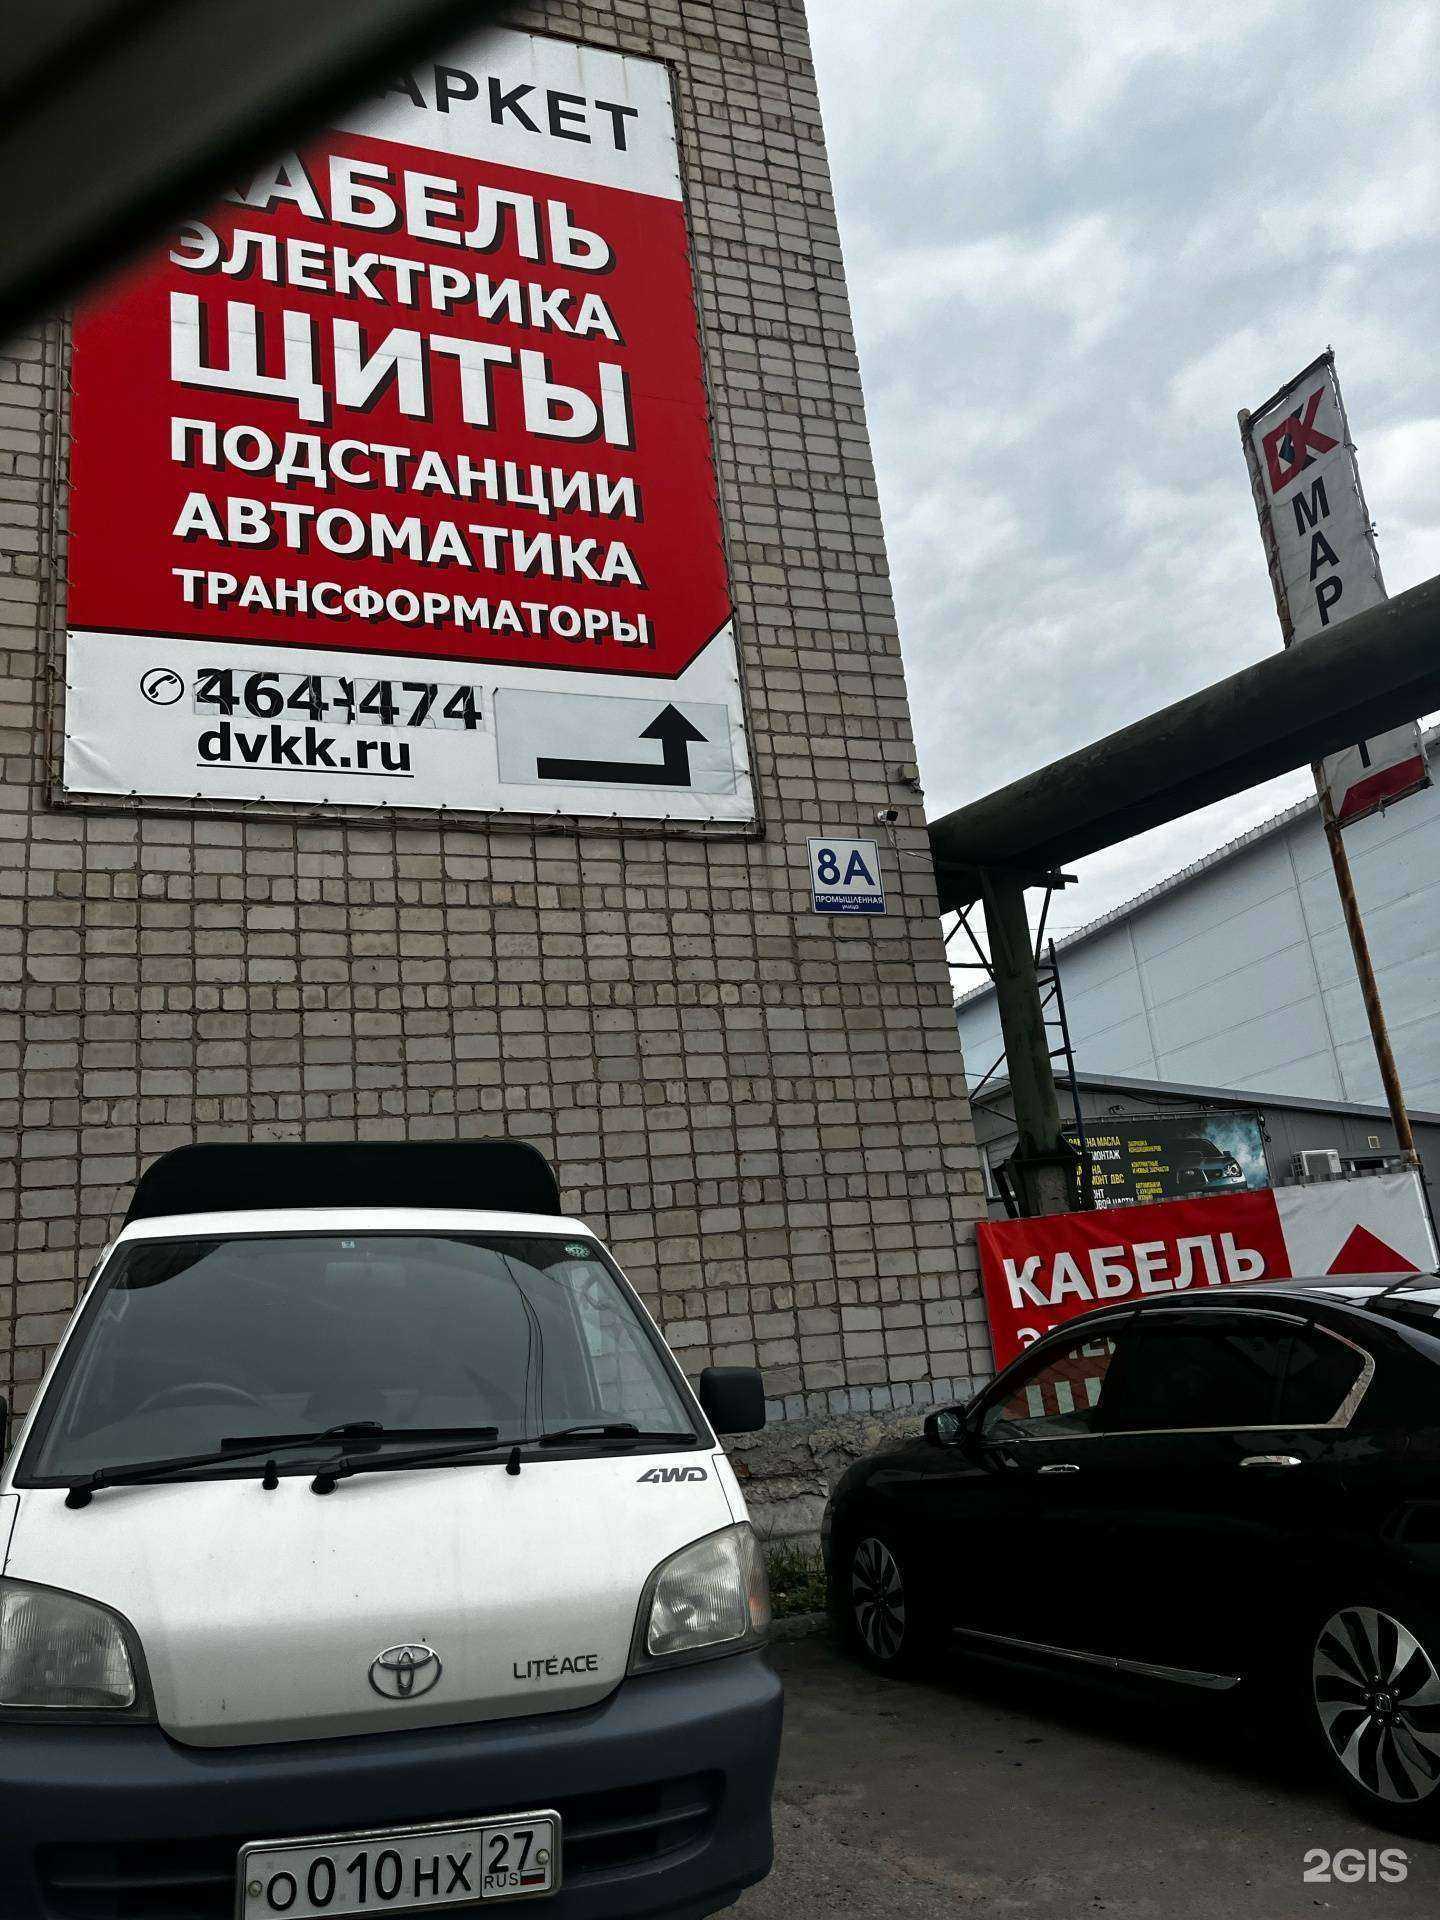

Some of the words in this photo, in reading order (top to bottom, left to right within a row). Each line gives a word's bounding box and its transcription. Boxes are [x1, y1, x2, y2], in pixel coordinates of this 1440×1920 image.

[223, 150, 612, 273] АБЕЛЬ
[169, 220, 619, 342] ЭЛЕКТРИКА
[170, 291, 630, 447] ЩИТЫ
[170, 416, 637, 518] ПОДСТАНЦИИ
[173, 491, 642, 585] АВТОМАТИКА
[172, 568, 650, 644] ТРАНСФОРМАТОРЫ
[197, 721, 412, 772] dvkk.ru
[815, 895, 883, 904] ПРОМЫШЛЕННАЯ
[817, 848, 876, 886] 8А
[1002, 1232, 1266, 1309] КАБЕЛЬ
[637, 1466, 708, 1484] 4WD
[484, 1872, 519, 1890] RUS
[488, 1830, 534, 1874] 27
